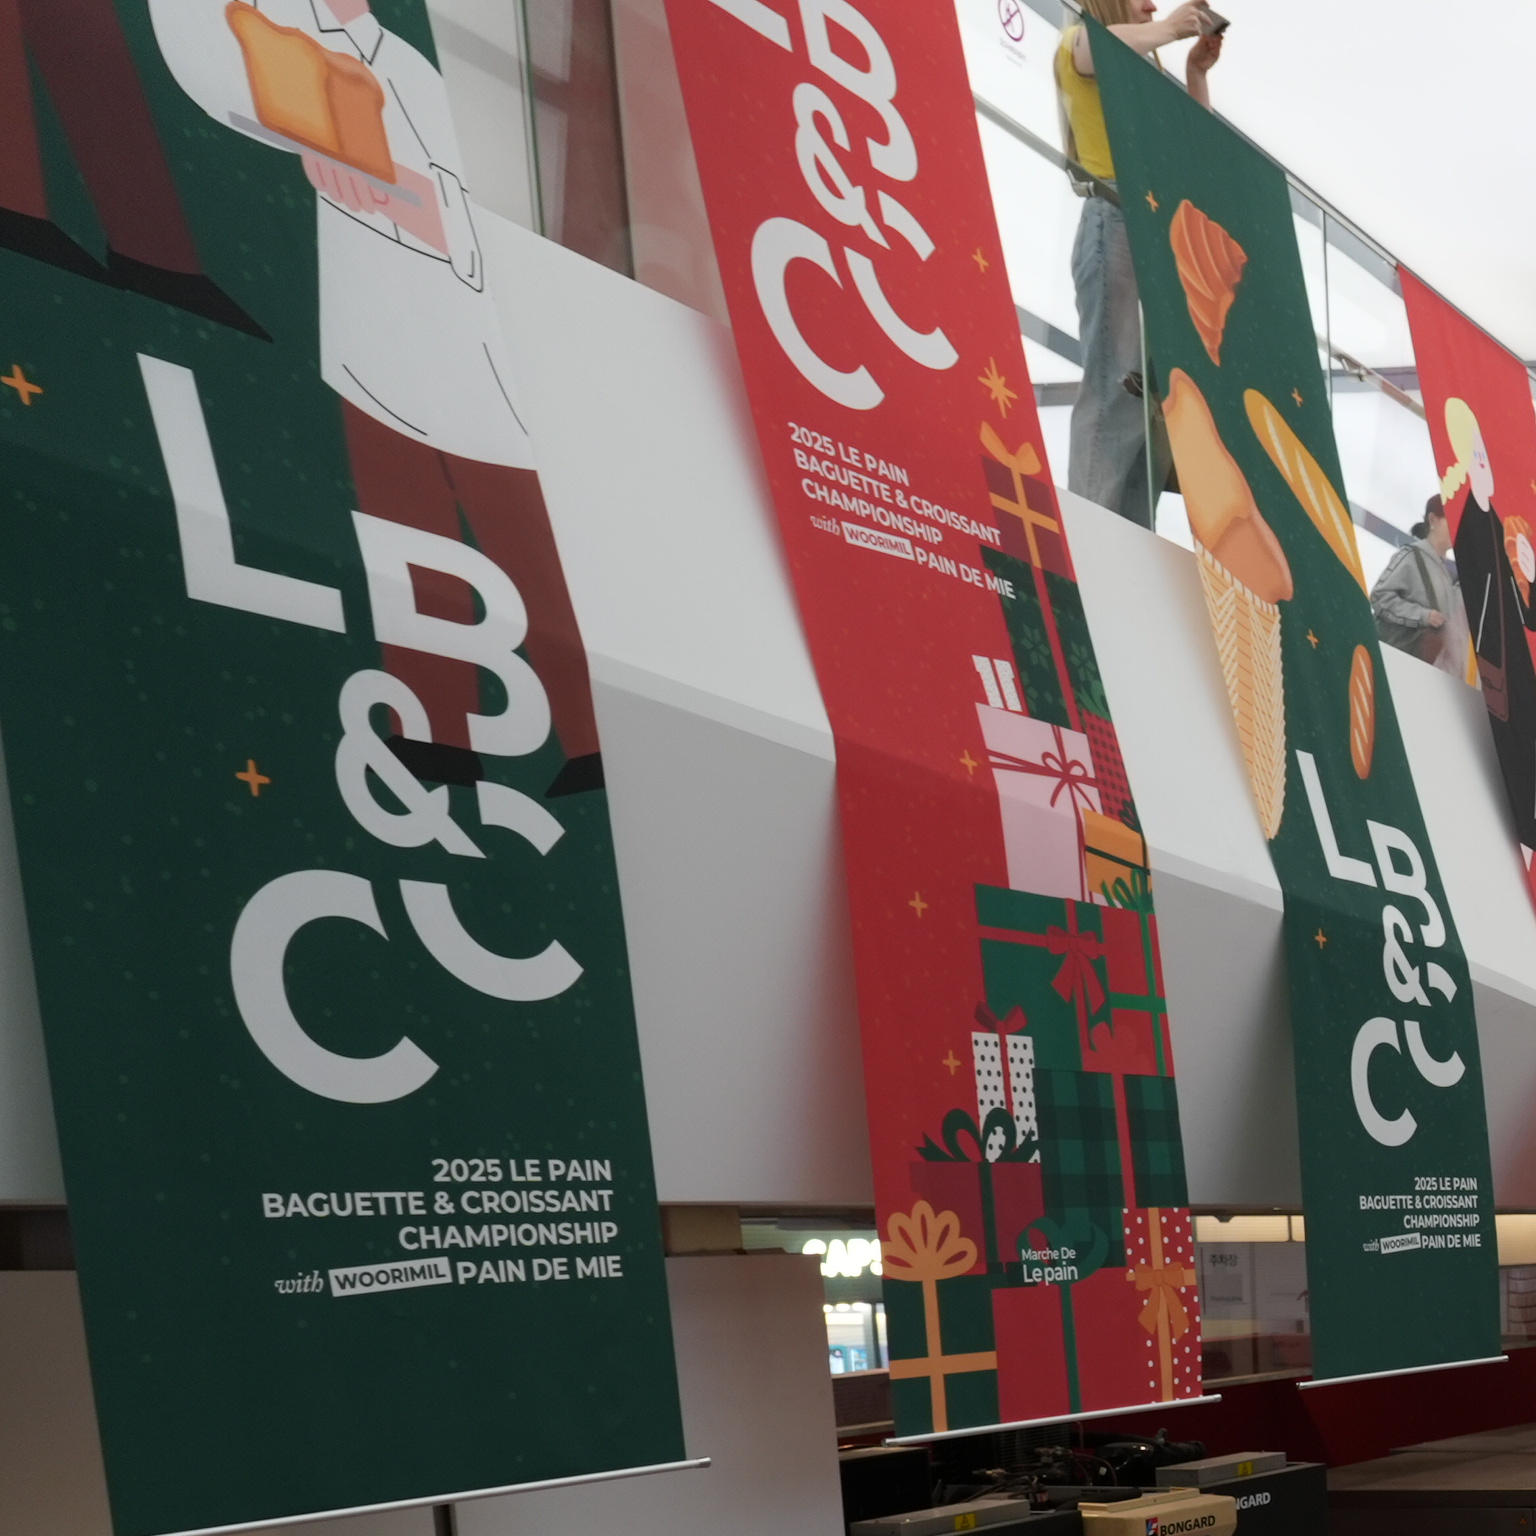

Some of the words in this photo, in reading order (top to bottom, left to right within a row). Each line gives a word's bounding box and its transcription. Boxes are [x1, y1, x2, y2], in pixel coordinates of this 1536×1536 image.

[788, 422, 835, 456] 2025
[838, 442, 863, 468] LE
[864, 453, 910, 486] PAIN
[793, 448, 893, 503] BAGUETTE
[895, 489, 909, 508] &
[910, 496, 1001, 546] CROISSANT
[801, 478, 943, 545] CHAMPIONSHIP
[810, 515, 841, 536] with
[847, 526, 912, 557] WOORIMIL
[914, 546, 958, 578] PAIN
[959, 562, 984, 588] DE
[985, 573, 1016, 600] MIE
[432, 1158, 502, 1182] 2025
[510, 1159, 542, 1181] LE
[550, 1159, 612, 1181] PAIN
[1414, 1177, 1437, 1190] 2025
[1440, 1178, 1451, 1190] LE
[1453, 1177, 1477, 1190] PAIN
[261, 1191, 427, 1218] BAGUETTE
[434, 1190, 455, 1214] &
[461, 1189, 614, 1214] CROISSANT
[1360, 1195, 1413, 1209] BAGUETTE
[1415, 1196, 1422, 1208] &
[1423, 1195, 1478, 1208] CROISSANT
[399, 1221, 618, 1250] CHAMPIONSHIP
[1404, 1214, 1480, 1228] CHAMPIONSHIP
[1022, 1247, 1059, 1260] Marche
[1061, 1247, 1076, 1259] De
[1382, 1236, 1420, 1250] WOORIMIL
[1422, 1235, 1445, 1249] PAIN
[1447, 1235, 1461, 1248] DE
[1463, 1234, 1481, 1247] MIE
[274, 1270, 324, 1294] with
[333, 1263, 447, 1291] WOORIMIL
[456, 1259, 526, 1285] PAIN
[532, 1257, 570, 1281] DE
[576, 1255, 623, 1278] MIE
